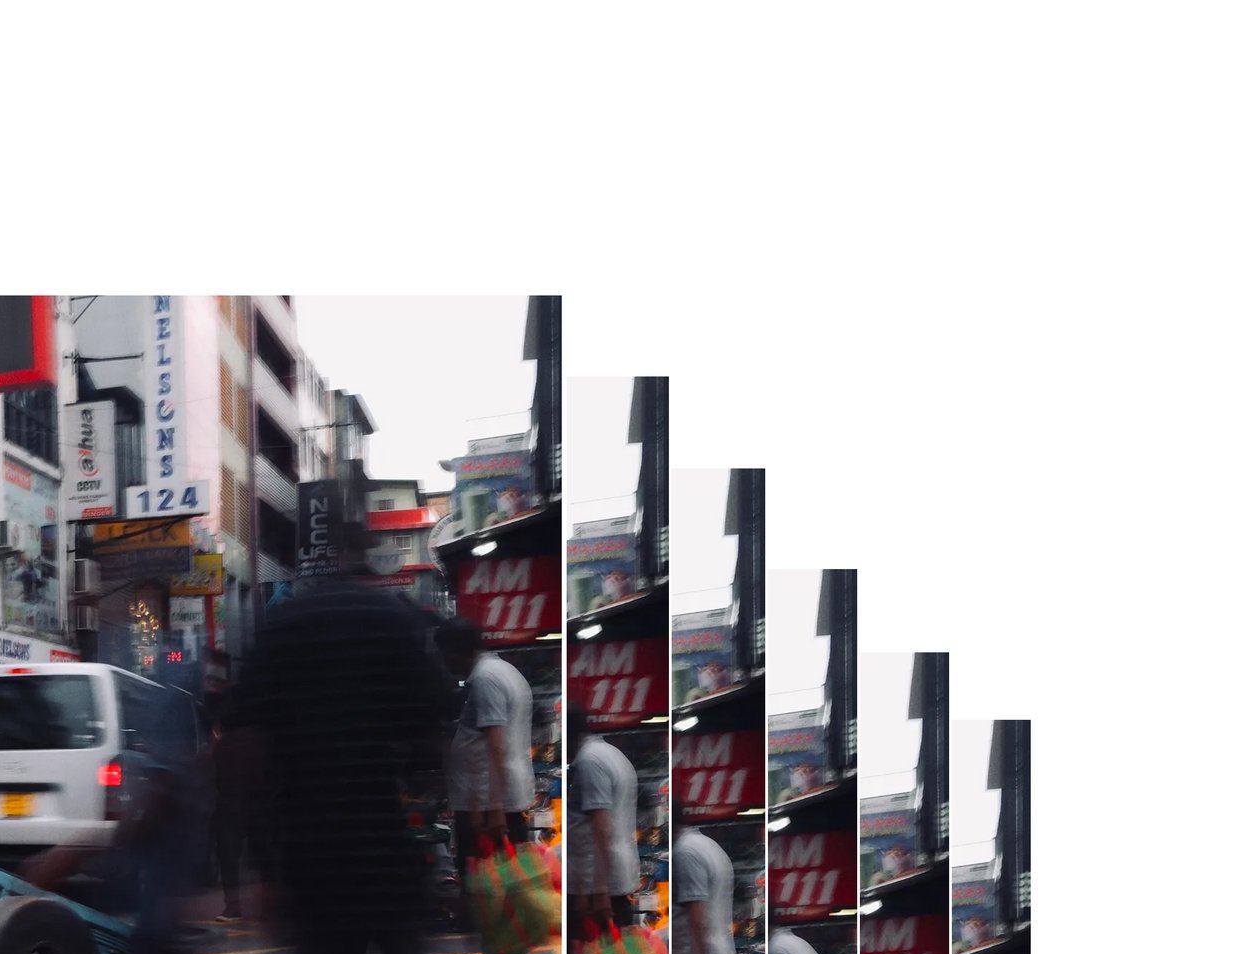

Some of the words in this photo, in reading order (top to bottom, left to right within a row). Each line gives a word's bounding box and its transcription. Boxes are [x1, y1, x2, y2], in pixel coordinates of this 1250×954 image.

[154, 295, 175, 478] NELSONS
[137, 486, 198, 513] 124
[465, 557, 533, 594] AM
[486, 593, 547, 629] 111
[571, 640, 638, 677] AM
[591, 677, 652, 713] 111
[672, 733, 734, 768] AM
[687, 768, 749, 804] 111
[777, 869, 841, 905] 111
